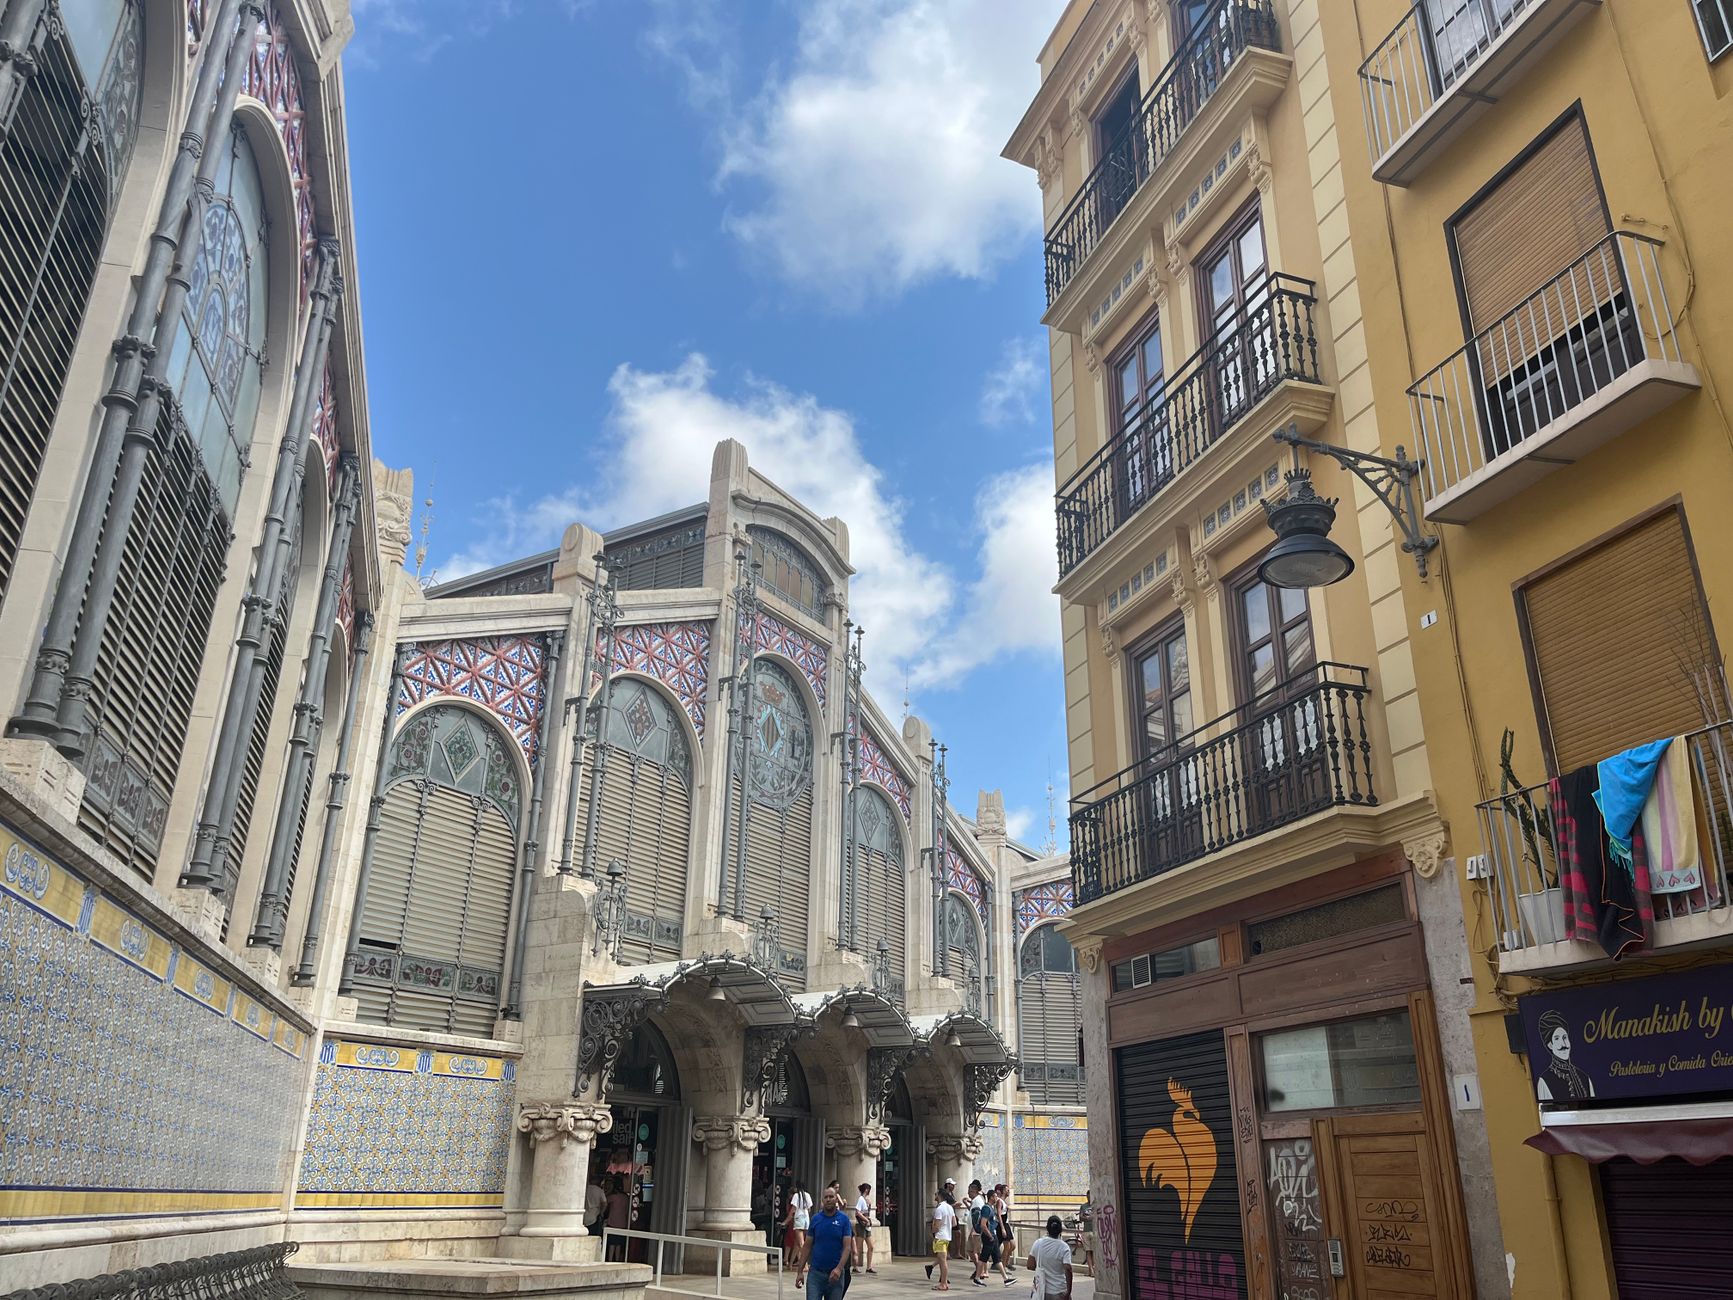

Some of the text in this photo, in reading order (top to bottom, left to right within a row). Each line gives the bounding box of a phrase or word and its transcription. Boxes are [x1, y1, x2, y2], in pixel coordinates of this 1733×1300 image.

[1583, 1000, 1693, 1044] Manakish
[1698, 996, 1724, 1040] by
[1656, 1062, 1666, 1078] y
[1668, 1054, 1706, 1072] Comida
